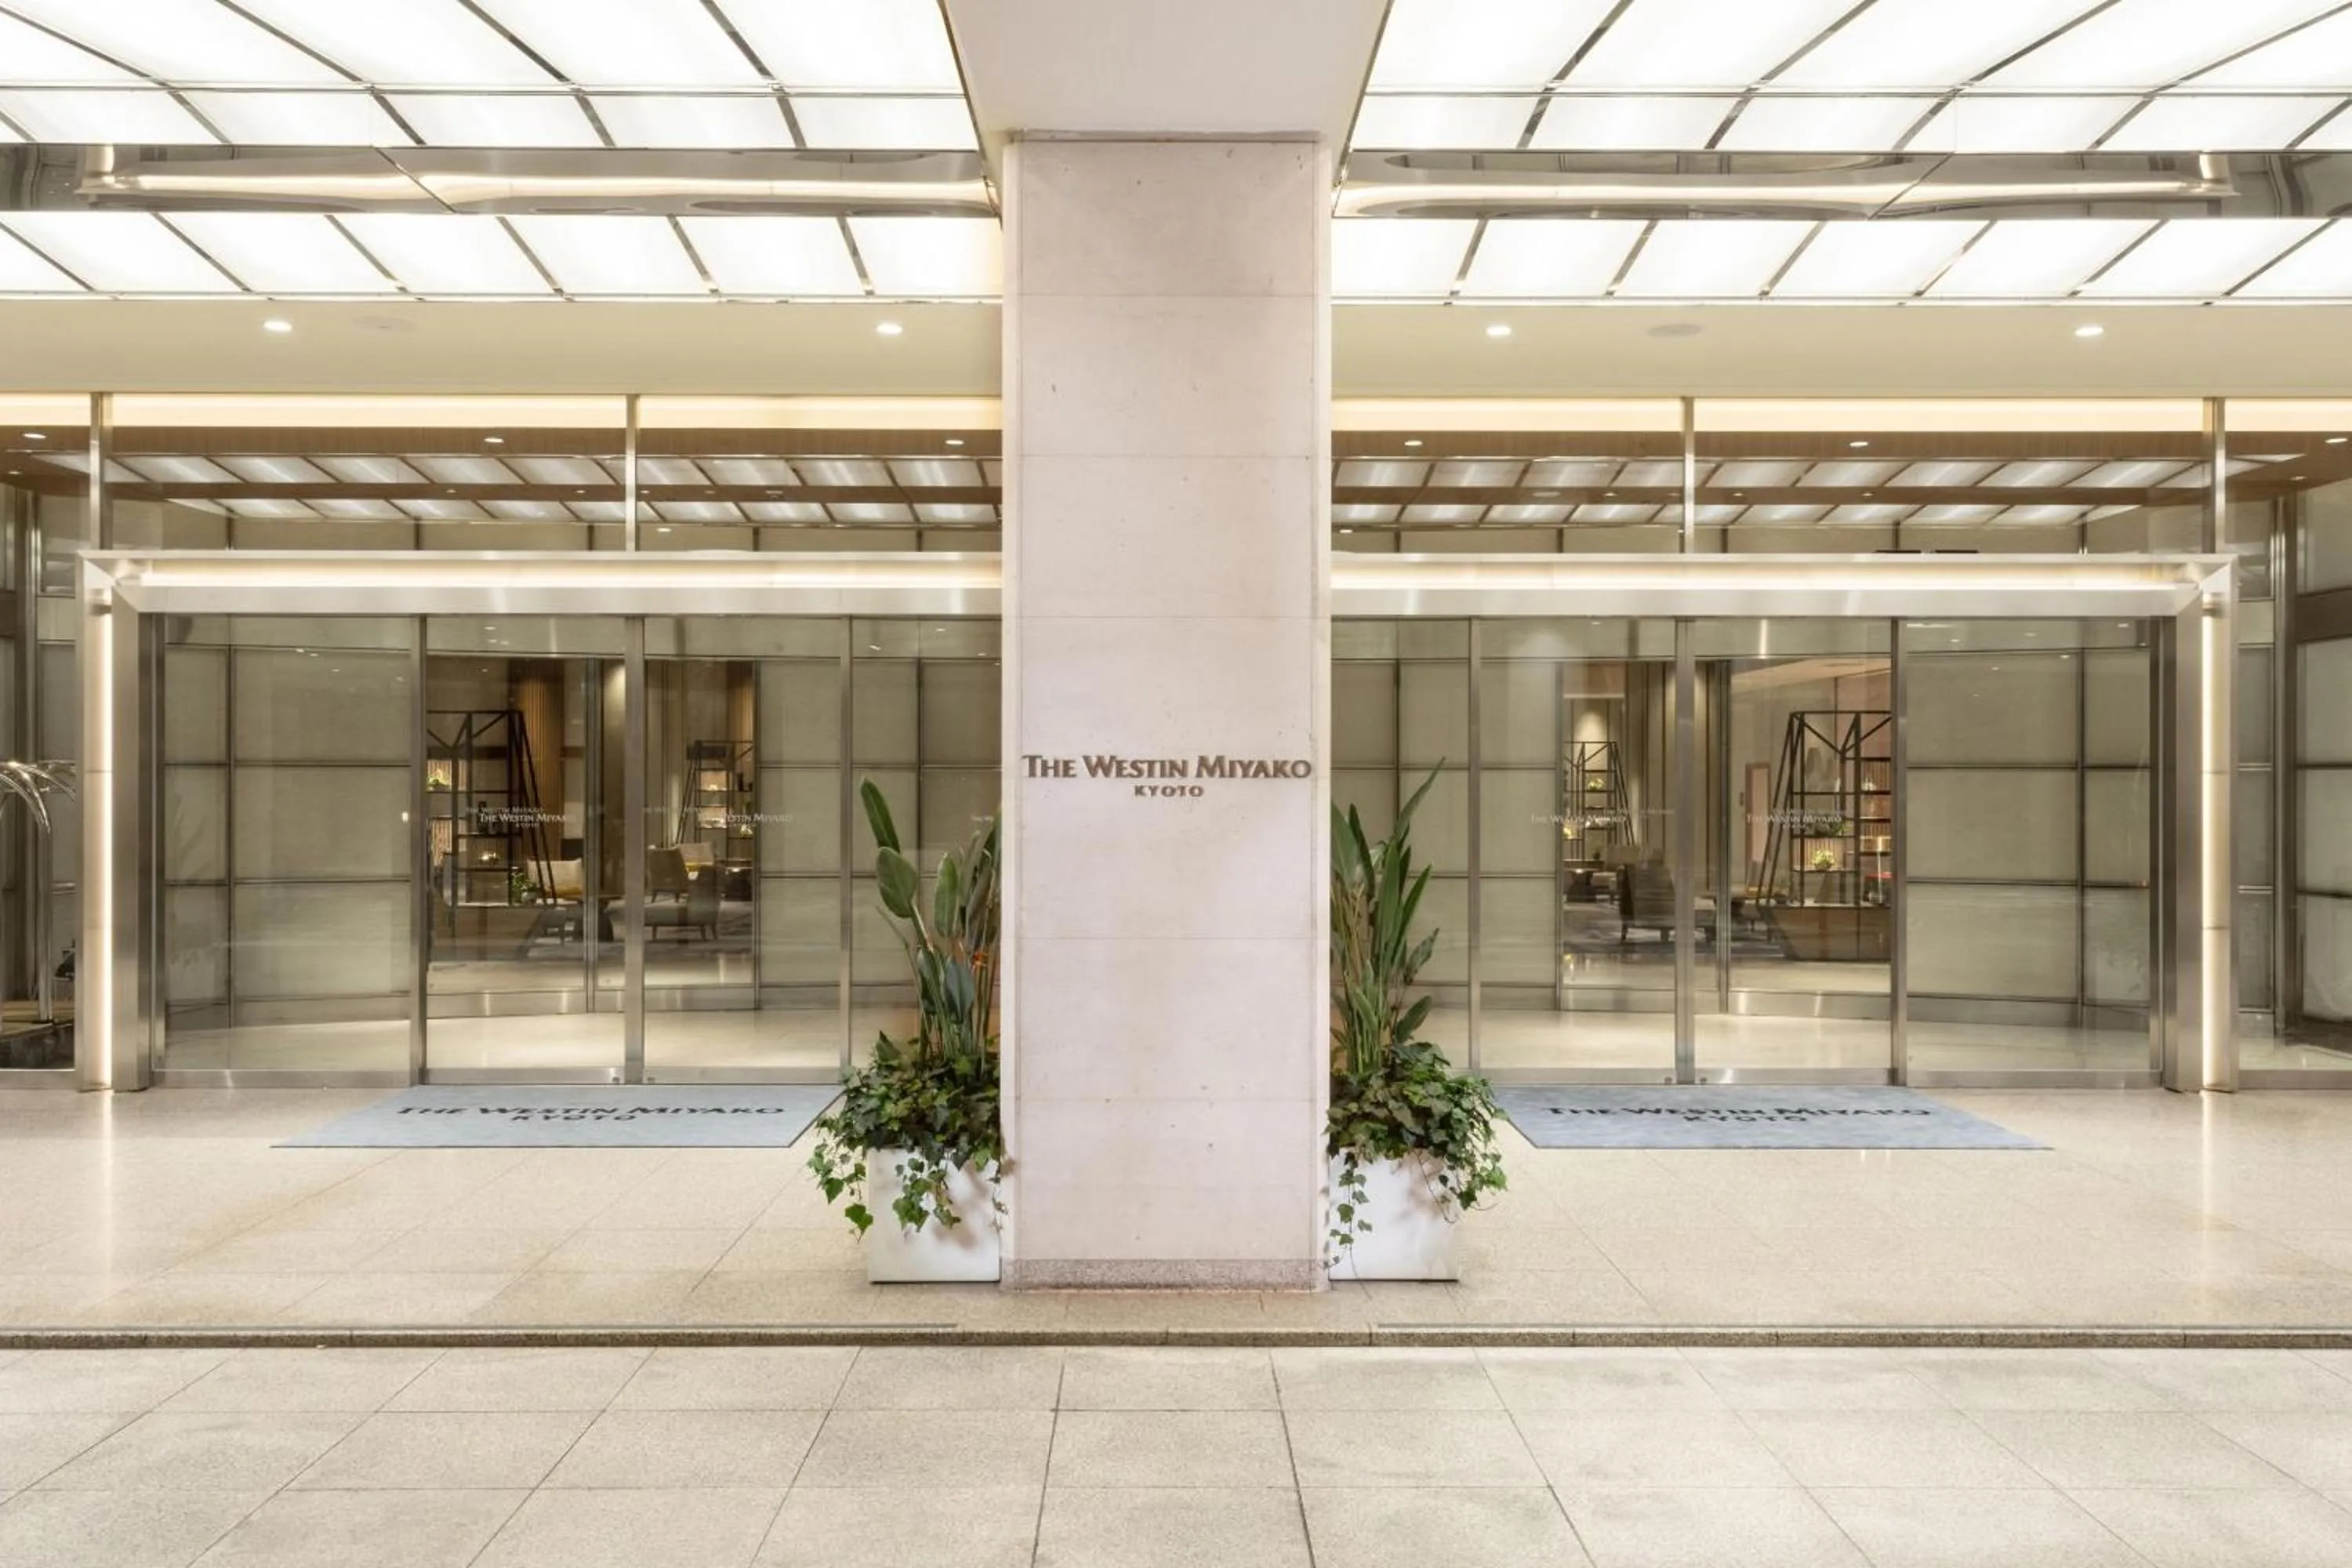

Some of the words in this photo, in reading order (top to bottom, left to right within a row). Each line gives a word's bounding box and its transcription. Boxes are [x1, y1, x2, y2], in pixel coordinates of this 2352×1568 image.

[1022, 754, 1077, 779] THE
[1082, 755, 1189, 779] WESTIN
[1195, 755, 1312, 779] MIYAKO
[1134, 785, 1204, 797] KYOTO
[479, 813, 499, 822] THE
[499, 813, 534, 822] WESTIN
